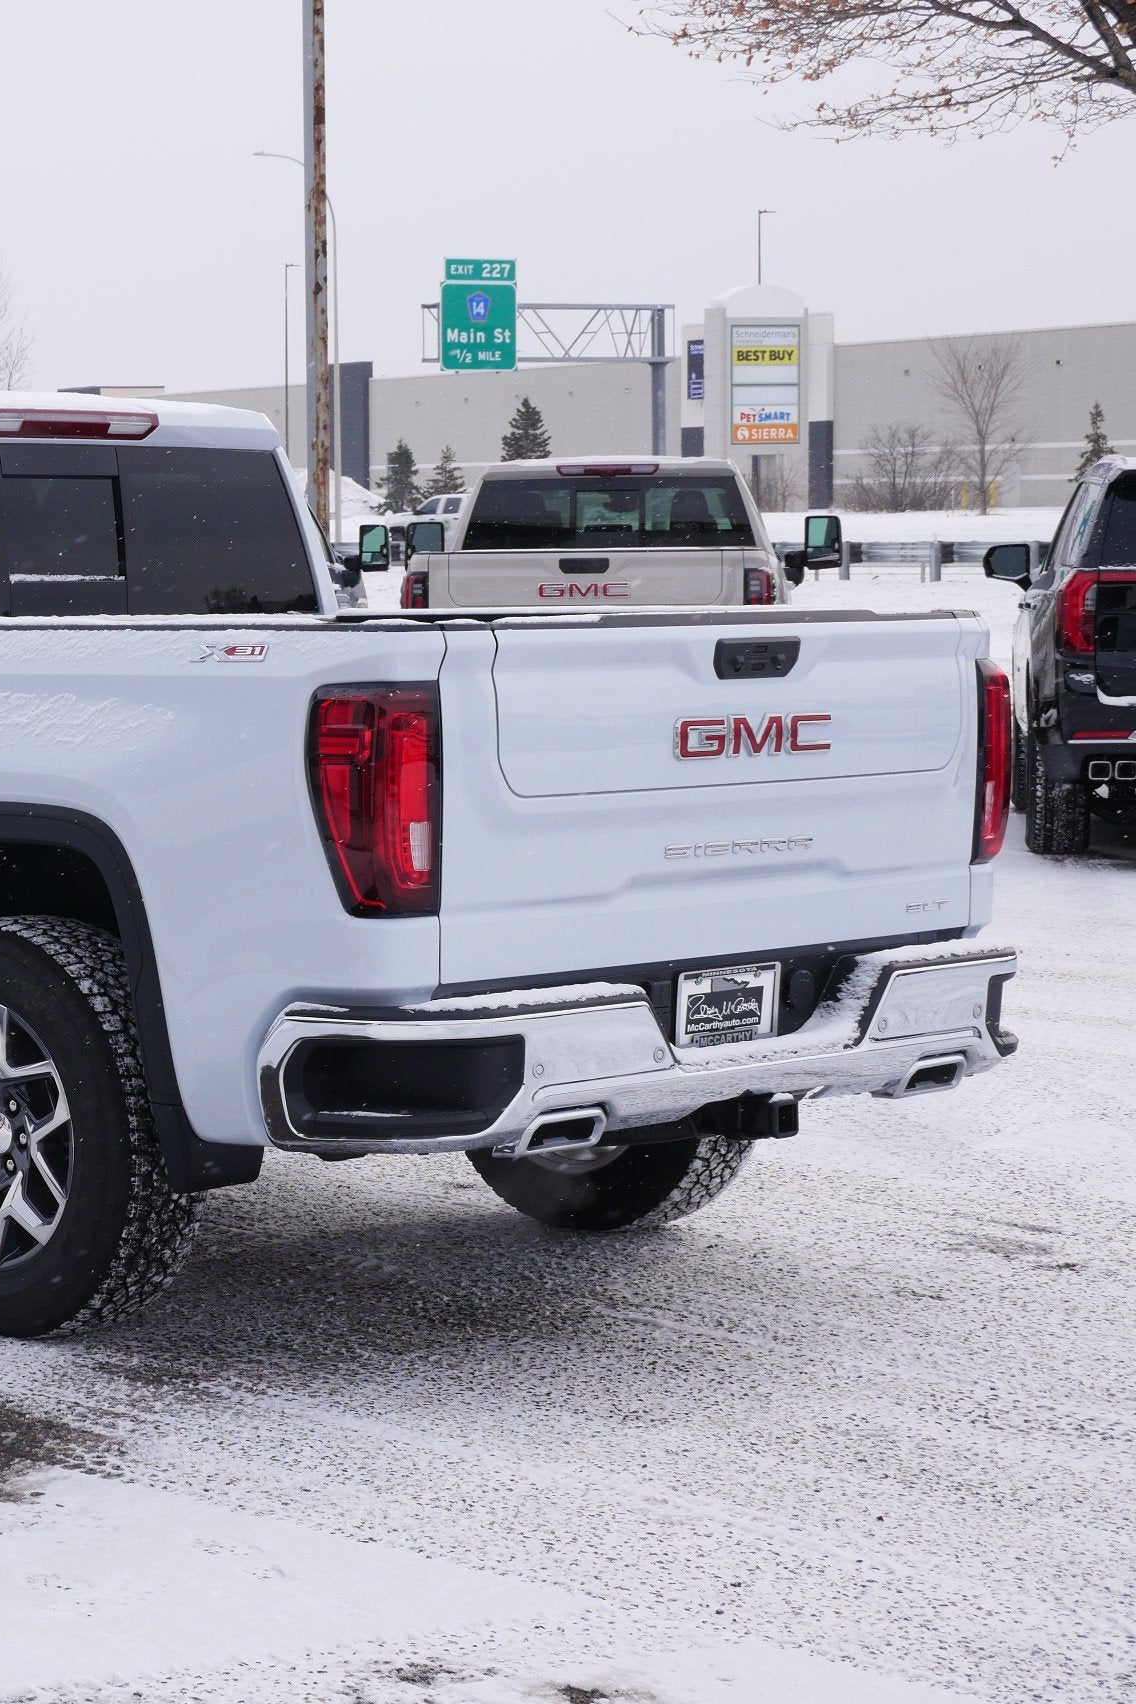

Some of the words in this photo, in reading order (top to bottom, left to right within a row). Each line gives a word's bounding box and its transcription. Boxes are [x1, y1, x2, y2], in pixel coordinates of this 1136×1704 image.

[450, 265, 474, 275] EXIT
[482, 263, 511, 278] 227
[472, 302, 485, 315] 14
[446, 328, 486, 343] Main
[494, 328, 511, 343] St
[478, 351, 502, 361] MILE
[736, 350, 767, 361] BEST
[769, 349, 795, 361] BUY
[751, 428, 794, 439] SIERRA
[538, 582, 631, 599] GMC
[673, 712, 832, 761] GMC
[665, 836, 814, 860] SIERRA
[906, 899, 951, 913] SLT
[702, 966, 758, 978] MINNESOTA
[687, 1016, 759, 1032] McCarthyauto.com
[699, 1030, 752, 1048] MCCARTHY
